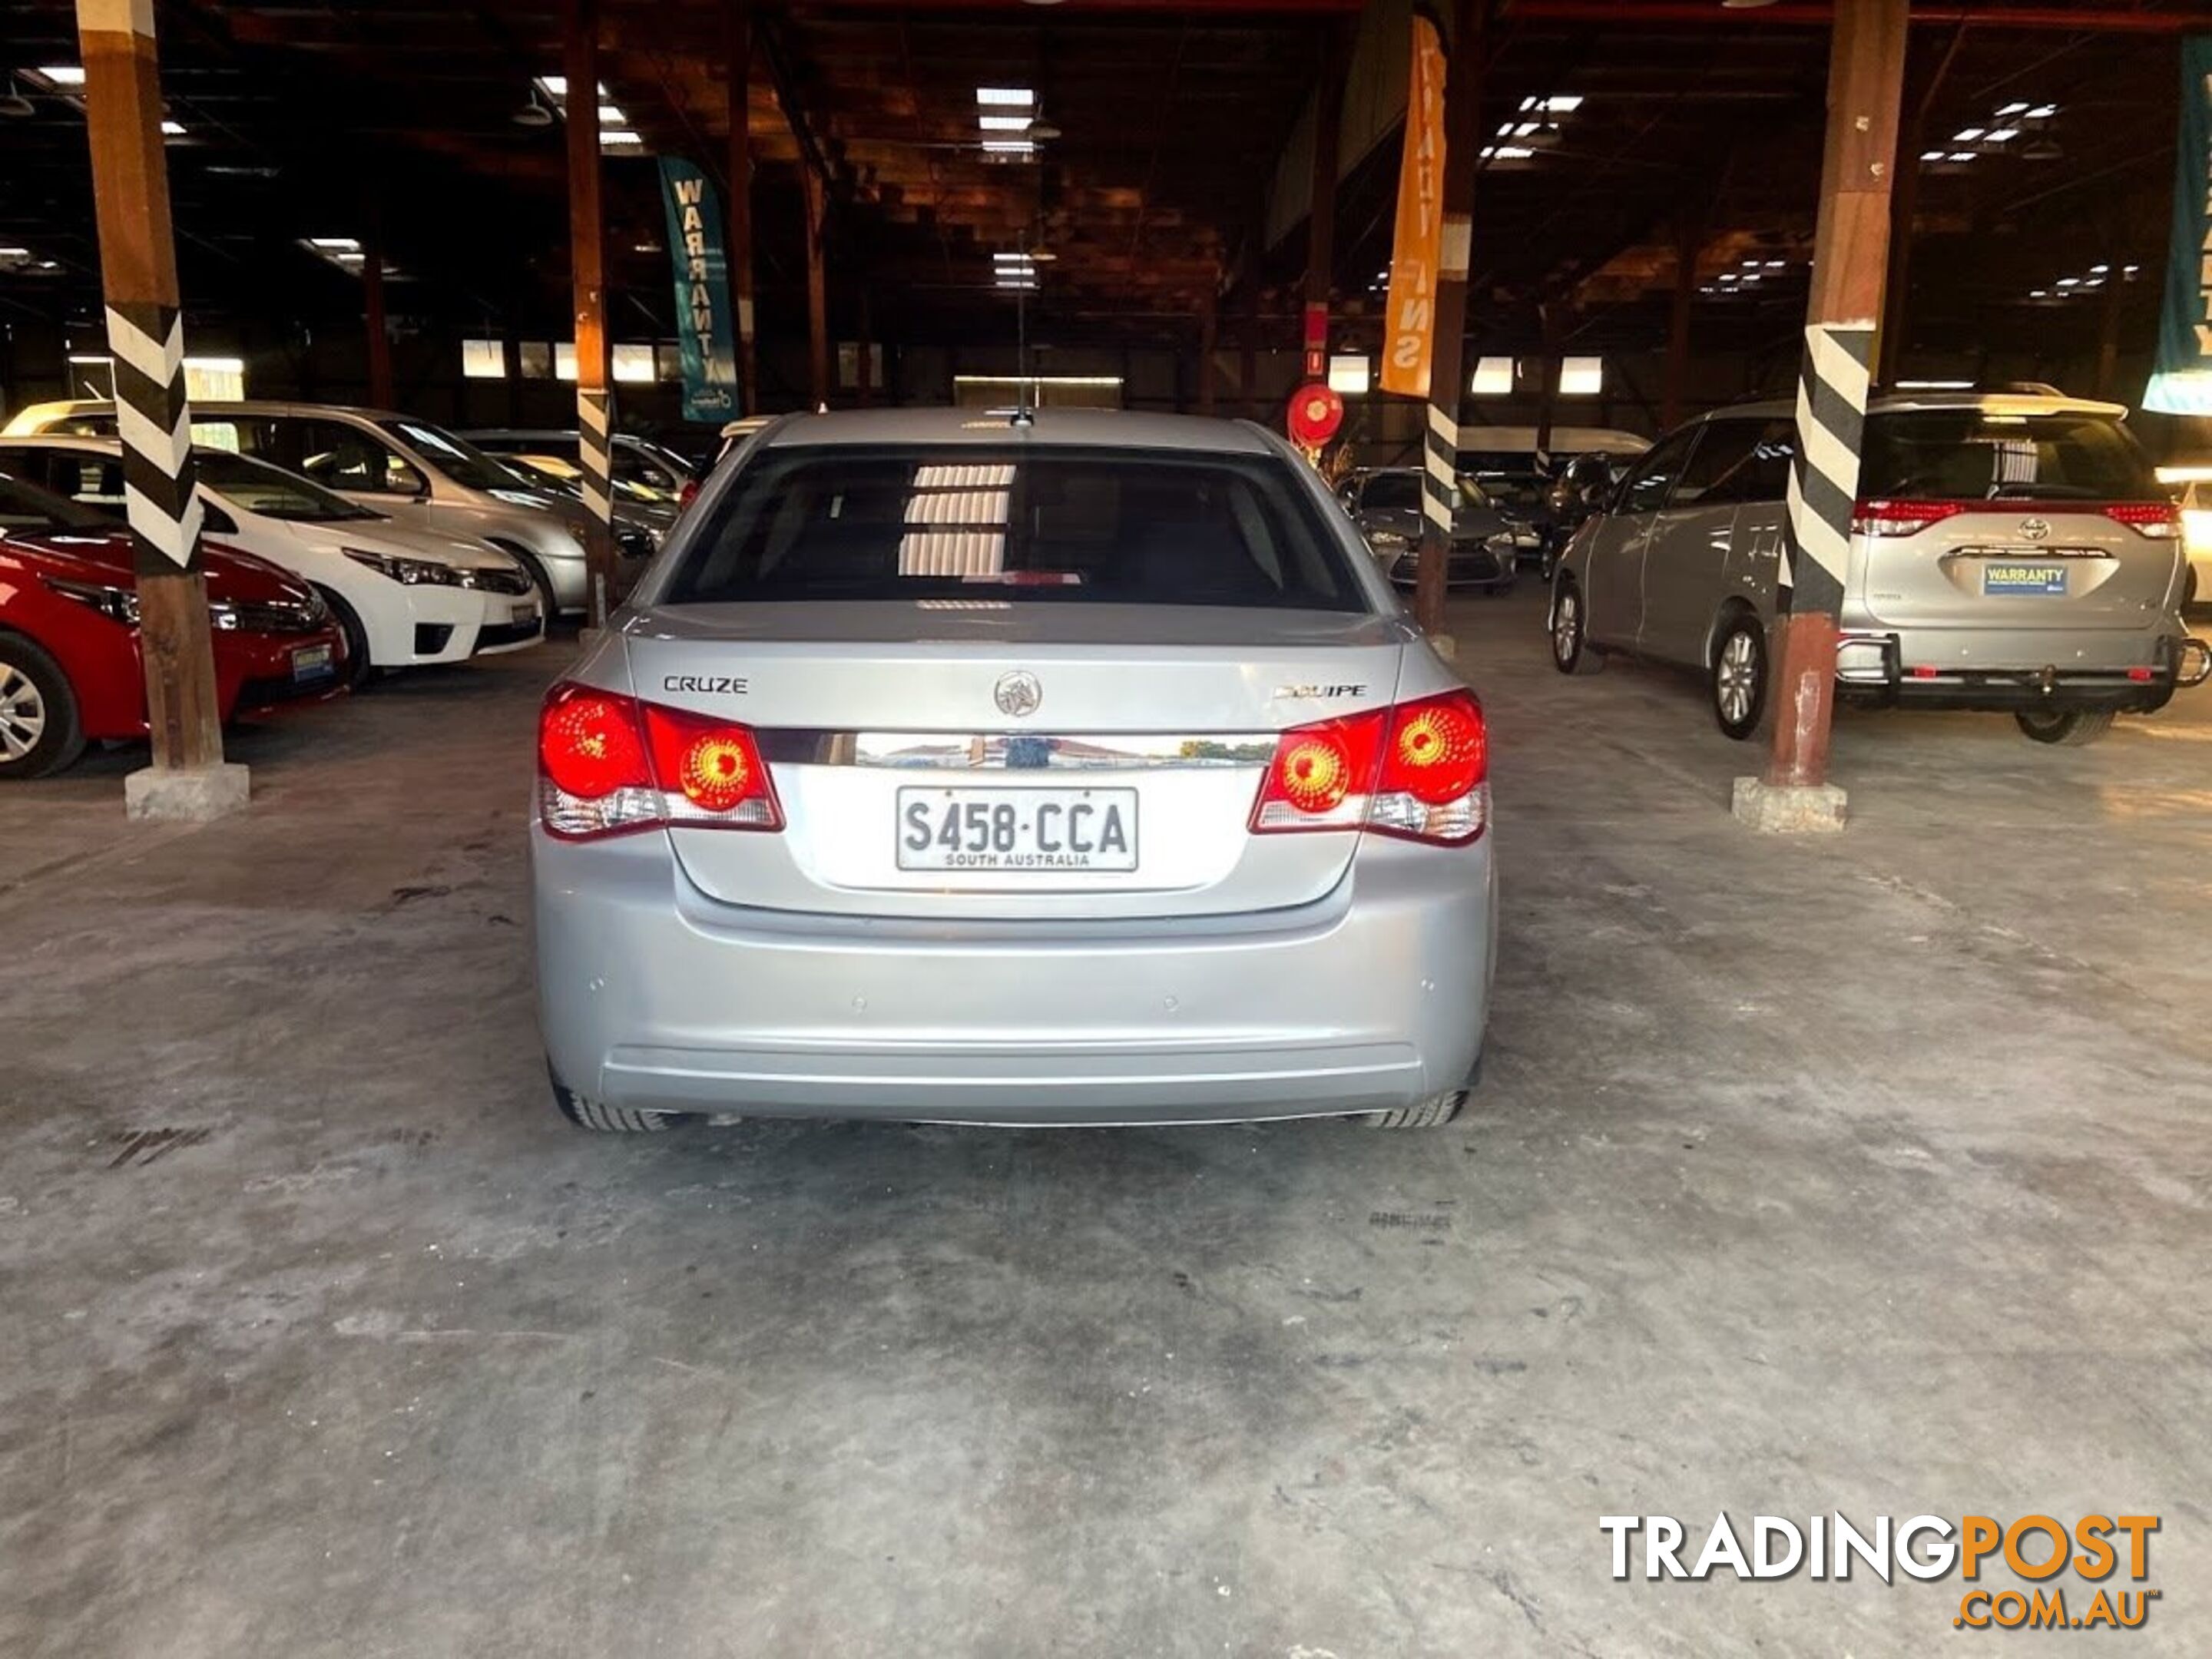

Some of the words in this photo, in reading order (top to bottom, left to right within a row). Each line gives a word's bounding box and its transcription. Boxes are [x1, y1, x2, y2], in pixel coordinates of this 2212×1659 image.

[1987, 568, 2064, 581] WARRANTY
[664, 676, 748, 694] CRUZE
[1273, 685, 1368, 698] UIPE
[945, 853, 998, 866] SOUTH
[1004, 853, 1090, 866] AUSTRALIA
